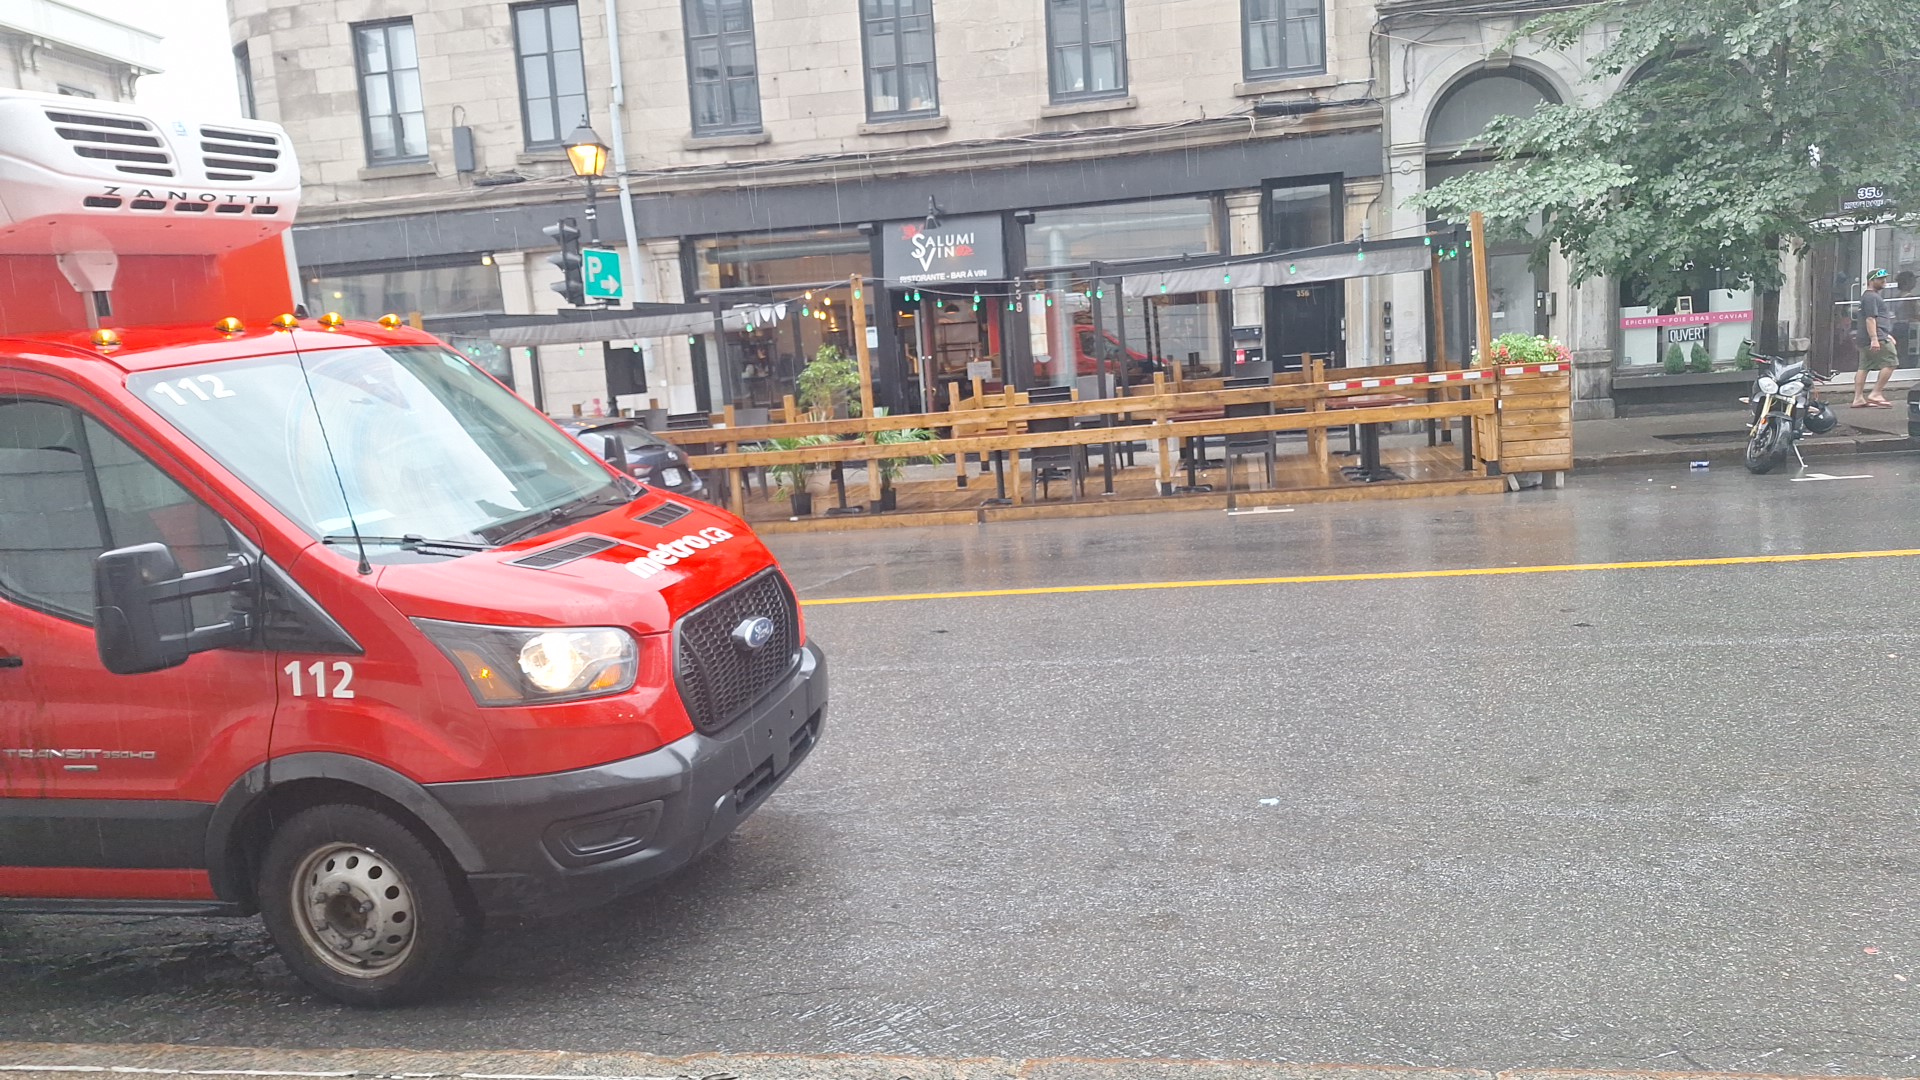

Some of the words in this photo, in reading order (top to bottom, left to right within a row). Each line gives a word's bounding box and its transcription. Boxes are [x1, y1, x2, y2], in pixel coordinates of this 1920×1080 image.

[103, 186, 272, 205] ZANOTTI
[911, 232, 975, 259] SALUMI
[587, 255, 603, 283] P
[899, 272, 946, 283] RISTORANTE
[950, 271, 967, 280] BAR
[973, 269, 987, 277] VIN
[1668, 316, 1687, 324] FOIE
[1689, 315, 1710, 323] GRAS
[1718, 312, 1748, 321] CAVIAR
[1669, 326, 1707, 342] OUVERT
[153, 373, 237, 406] 112
[624, 526, 734, 579] metro.ca
[284, 660, 355, 699] 112
[4, 748, 102, 760] TRANSIT
[102, 750, 157, 760] 350HD
